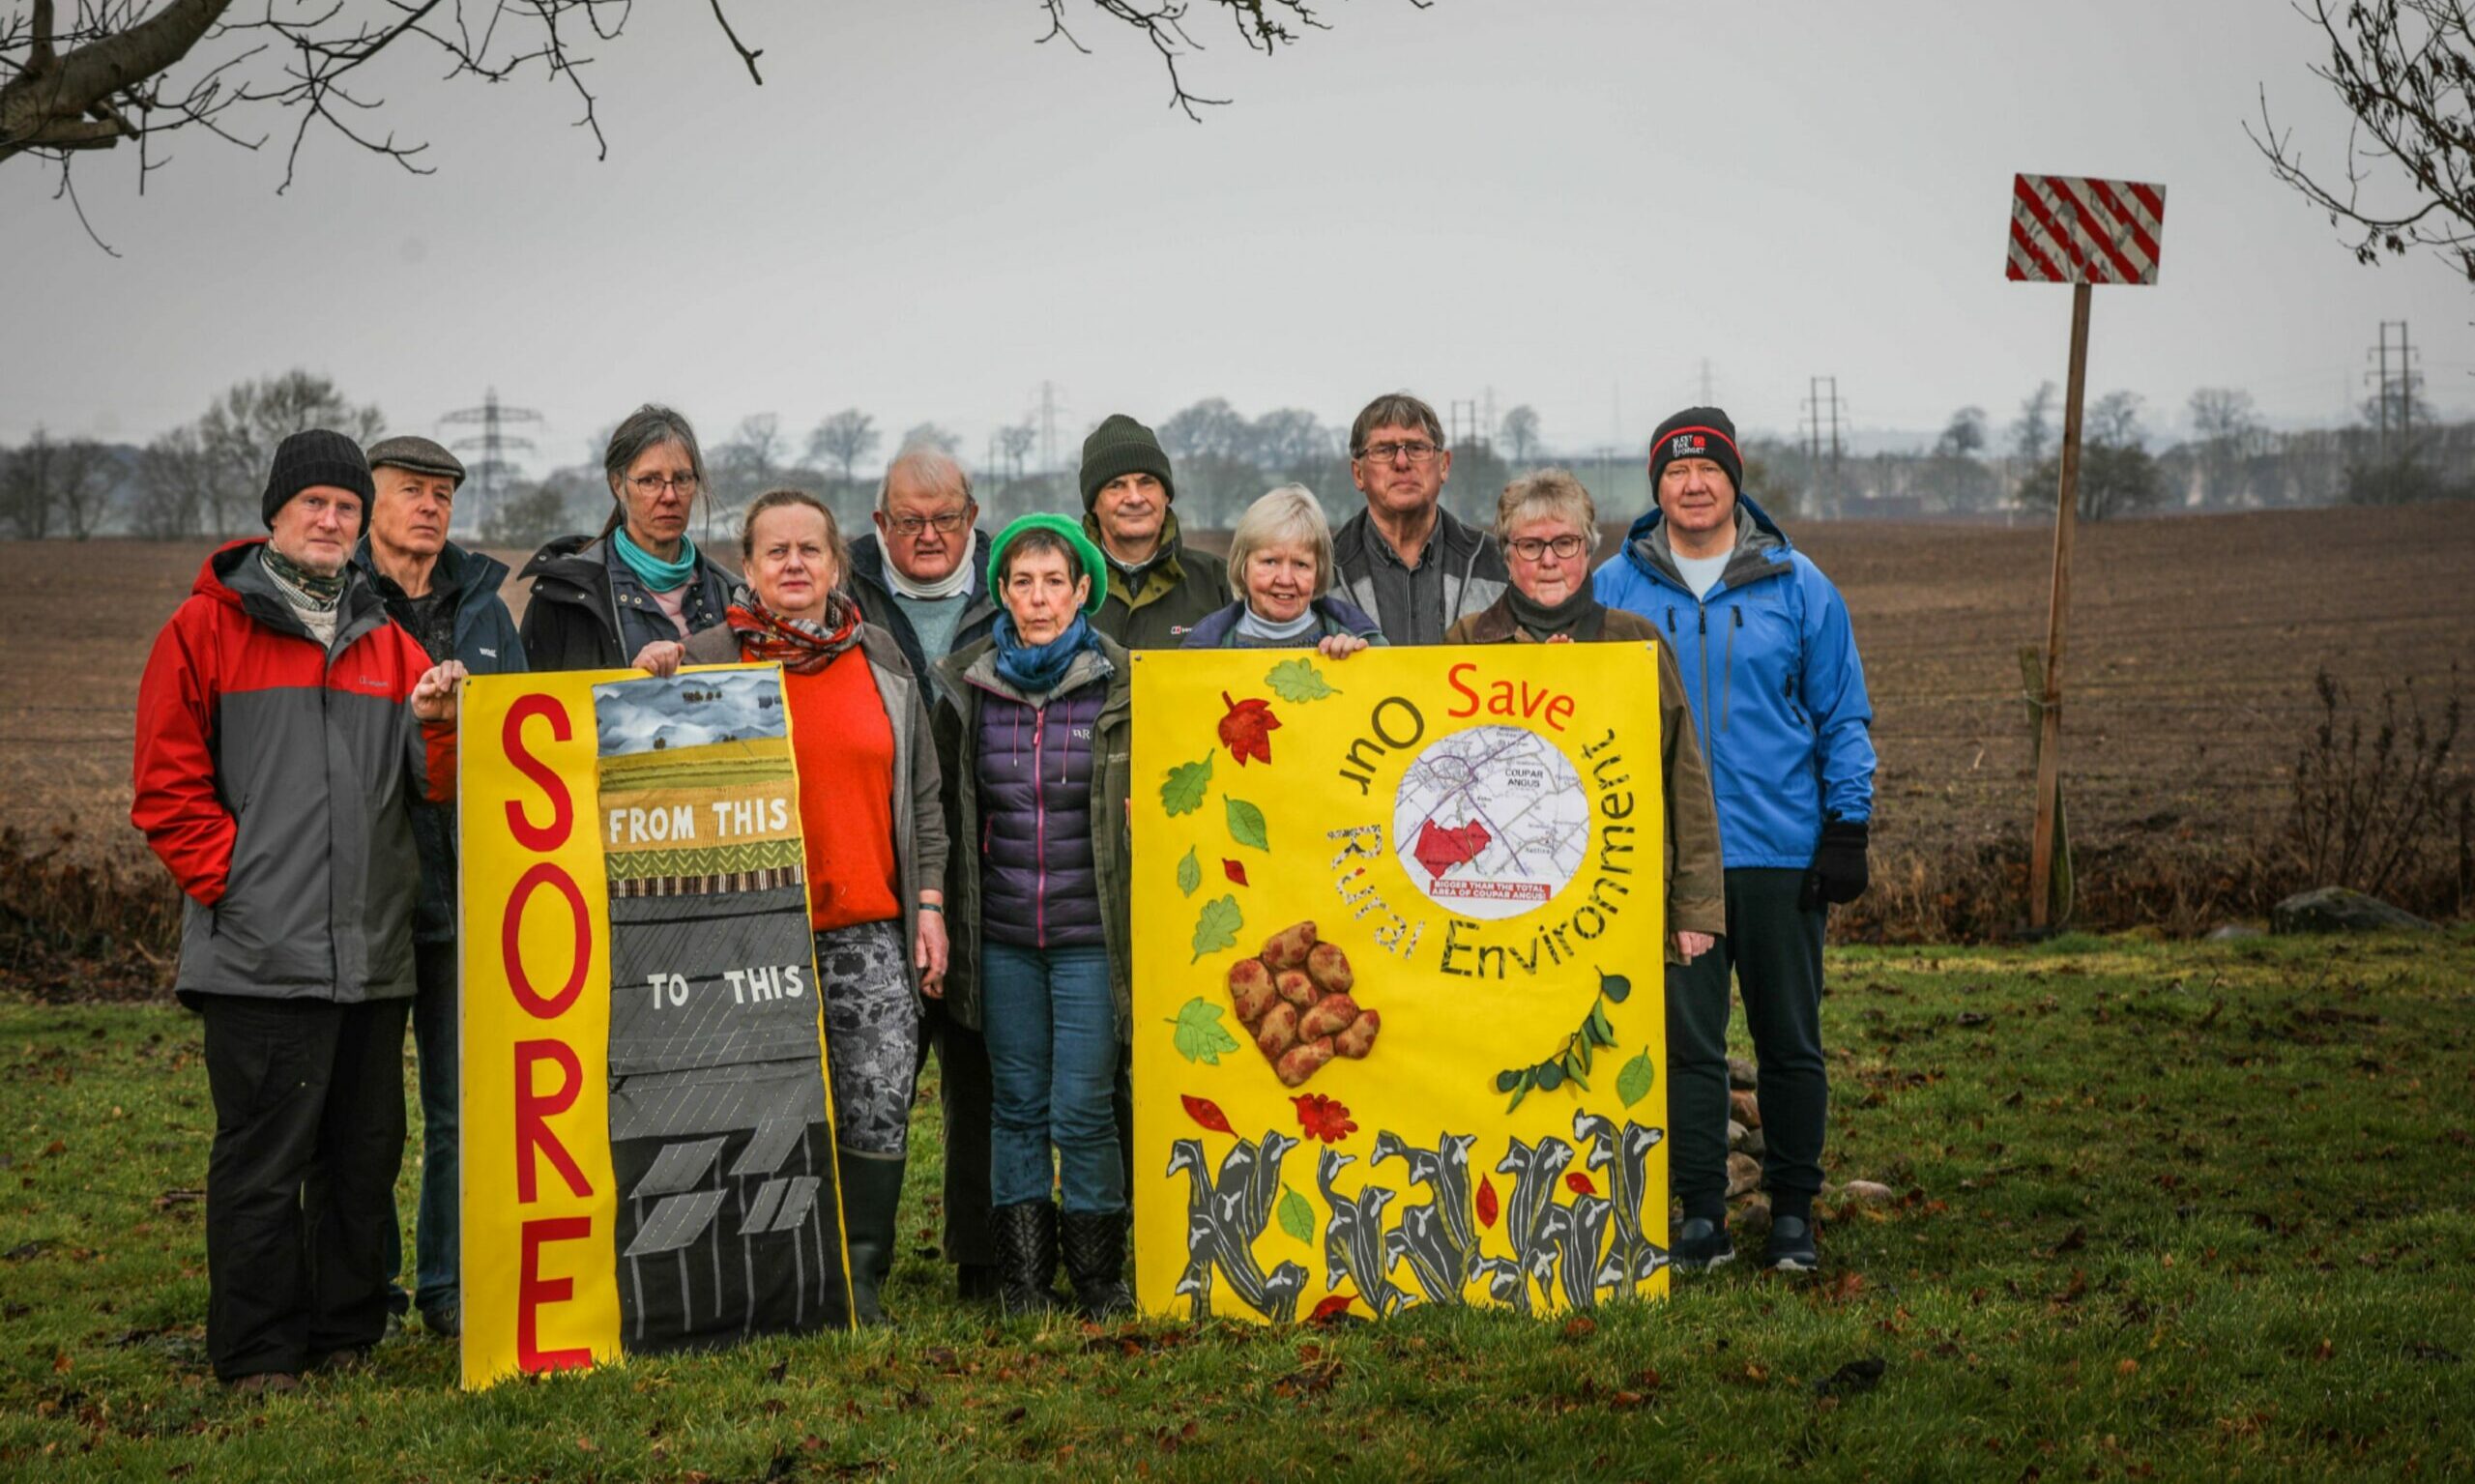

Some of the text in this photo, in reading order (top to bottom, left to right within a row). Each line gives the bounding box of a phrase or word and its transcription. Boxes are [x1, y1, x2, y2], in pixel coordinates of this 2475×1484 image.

[1505, 770, 1543, 778] COUPAR
[1508, 778, 1539, 787] ANGUS
[608, 799, 788, 843] FROM THIS
[1326, 663, 1635, 980] Save Our Rural Environment
[646, 965, 804, 1009] TO THIS
[501, 692, 595, 1373] SORE
